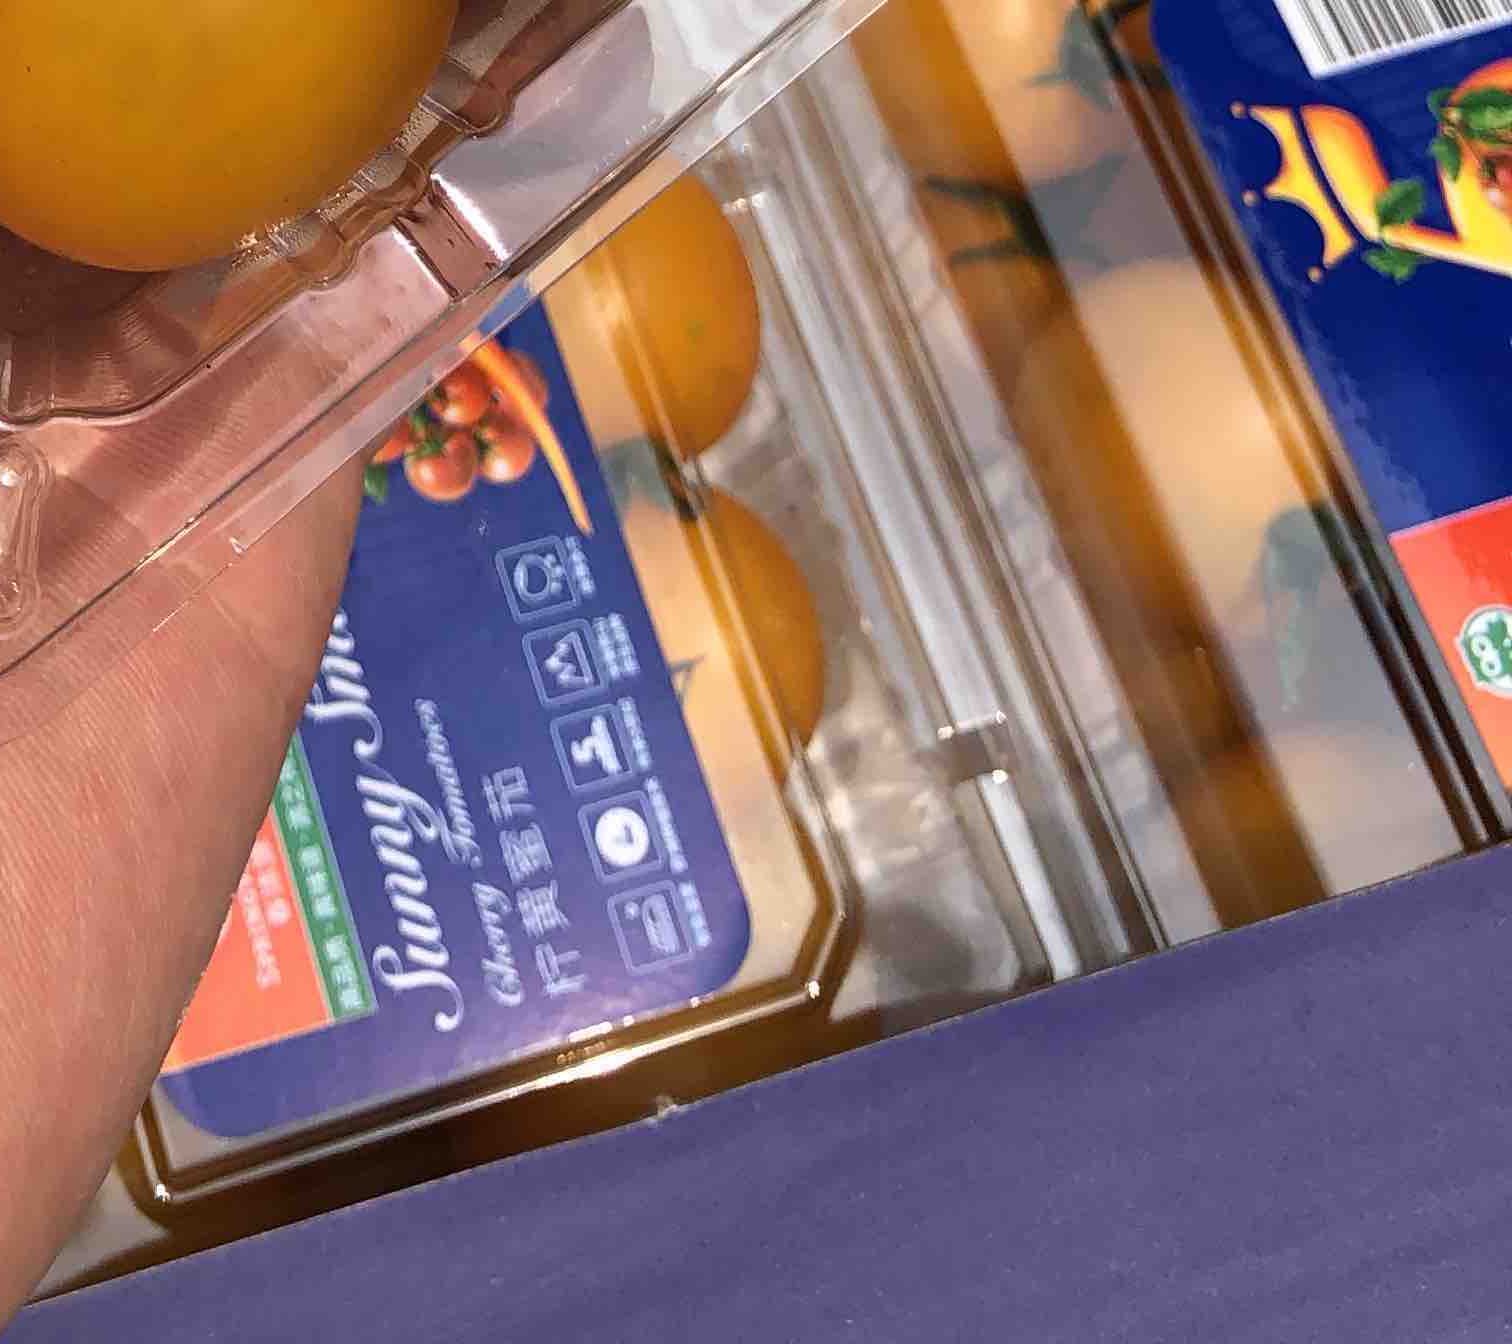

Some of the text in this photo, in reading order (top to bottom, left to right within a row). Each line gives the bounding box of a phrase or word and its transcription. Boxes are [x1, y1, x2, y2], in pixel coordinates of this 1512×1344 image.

[355, 770, 466, 1032] Sunny
[414, 698, 525, 1007] Cherry Tomatoes
[483, 766, 586, 999] 柠黄蜜茄
